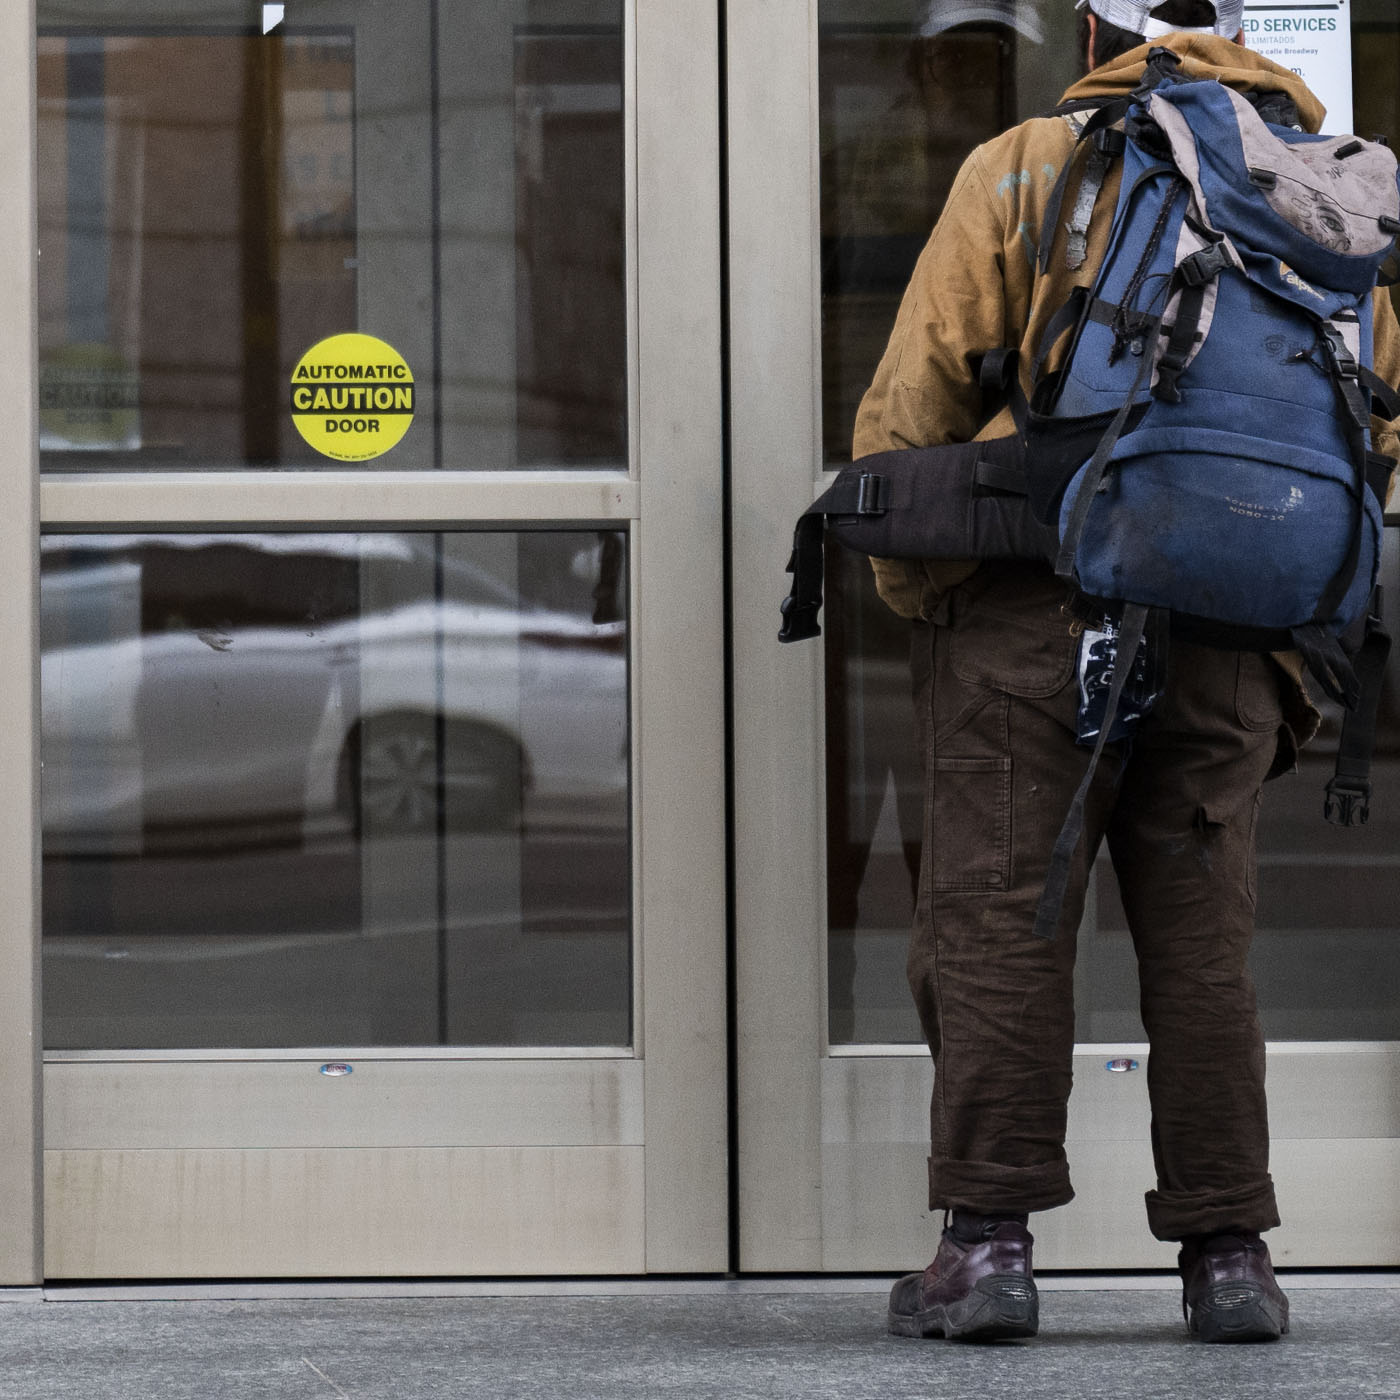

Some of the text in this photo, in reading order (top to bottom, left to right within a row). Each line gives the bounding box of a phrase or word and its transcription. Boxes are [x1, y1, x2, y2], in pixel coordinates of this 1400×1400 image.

[1263, 18, 1337, 31] SERVICES
[1251, 36, 1296, 45] LIMITADOS
[1284, 48, 1319, 56] Broadway
[297, 364, 407, 379] AUTOMATIC
[293, 386, 413, 410] CAUTION
[325, 419, 380, 433] DOOR
